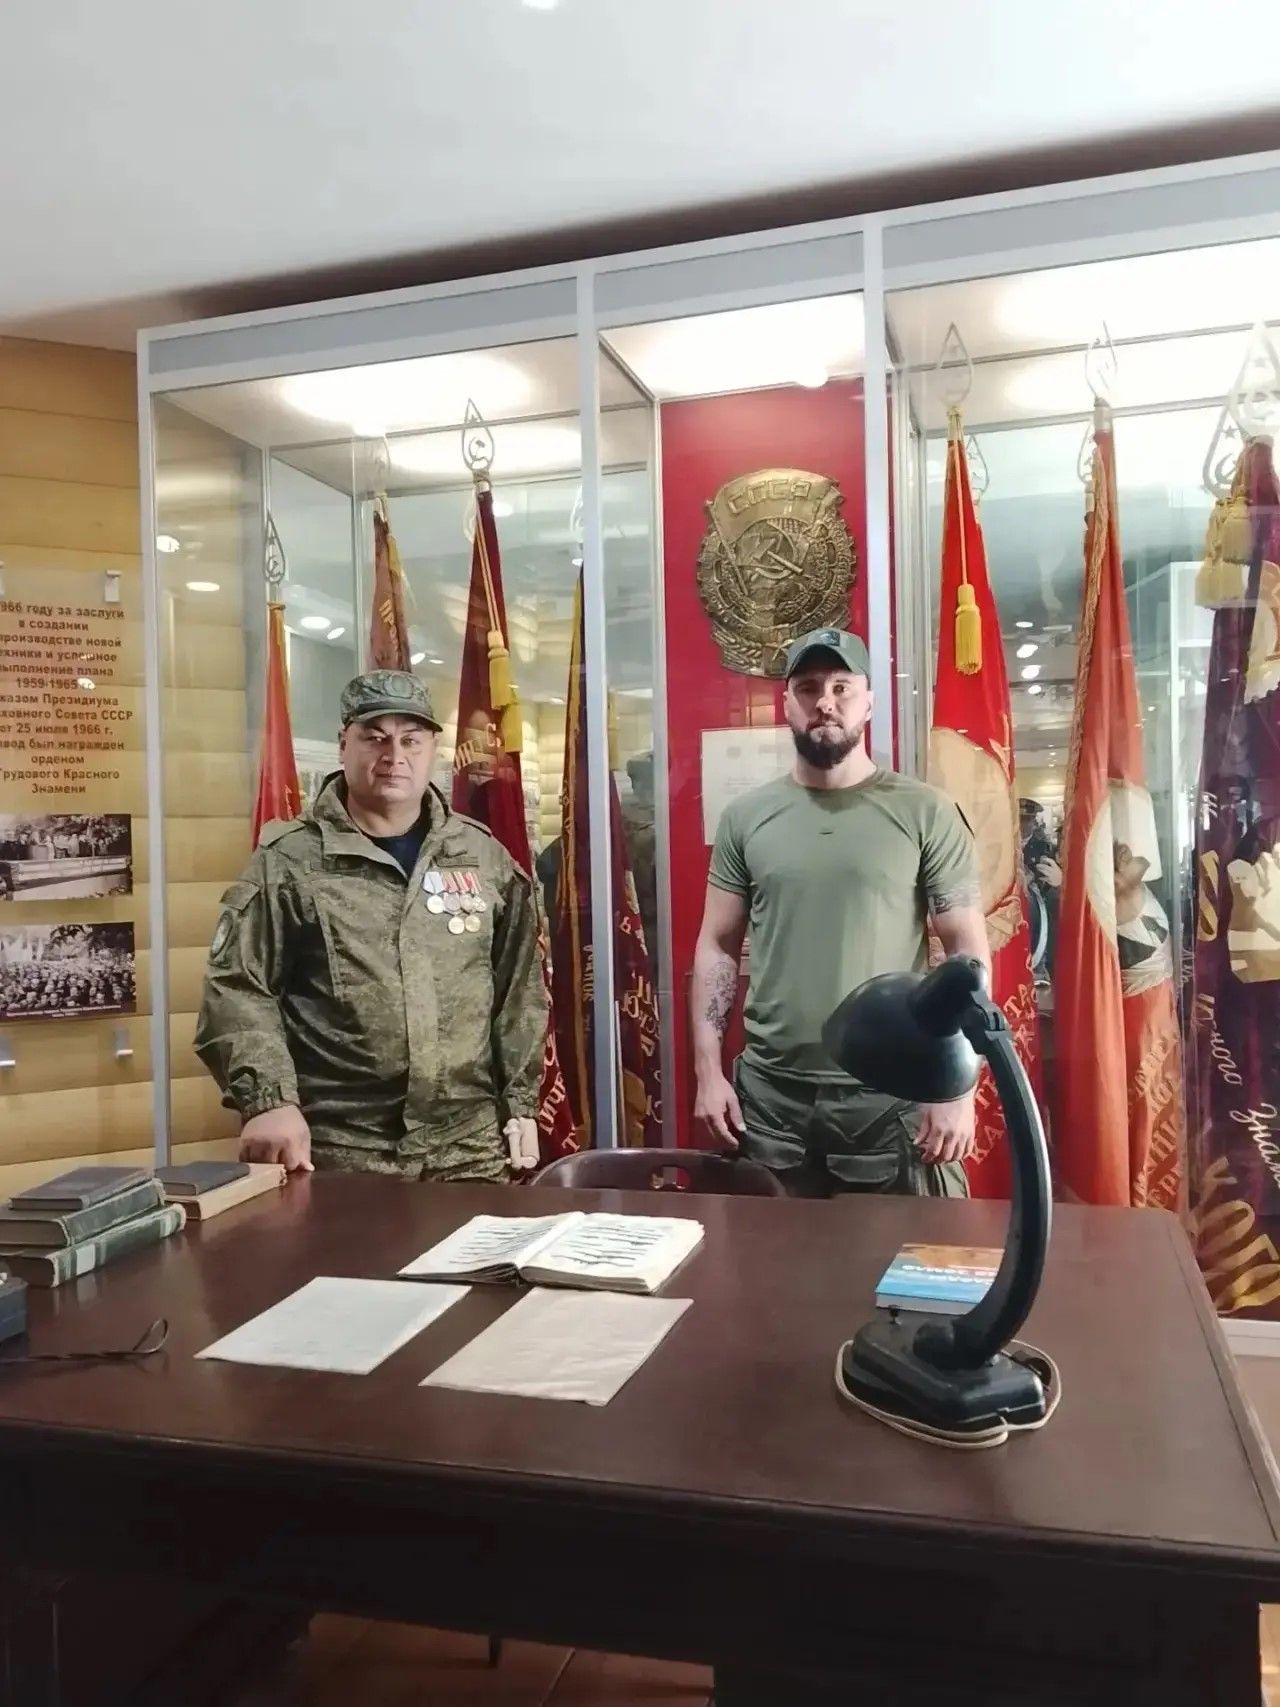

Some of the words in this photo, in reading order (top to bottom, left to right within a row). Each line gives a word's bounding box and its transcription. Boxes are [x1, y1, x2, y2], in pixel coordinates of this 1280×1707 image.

[728, 479, 811, 514] СССР
[27, 605, 52, 616] году
[58, 607, 72, 616] за
[76, 608, 124, 619] заслуги
[19, 620, 25, 628] в
[29, 620, 88, 631] создании
[86, 637, 121, 647] новой
[46, 651, 53, 659] и
[77, 668, 113, 676] плана
[43, 693, 118, 707] Президиума
[55, 708, 97, 720] Совета
[101, 710, 133, 720] СССР
[16, 722, 31, 733] 25
[73, 723, 101, 735] 1966
[105, 726, 113, 735] г.
[29, 738, 54, 749] был
[58, 742, 124, 751] награжден
[31, 756, 84, 766] орденом
[0, 769, 59, 781] рудового
[63, 768, 120, 781] Красного
[31, 783, 86, 794] Знамени
